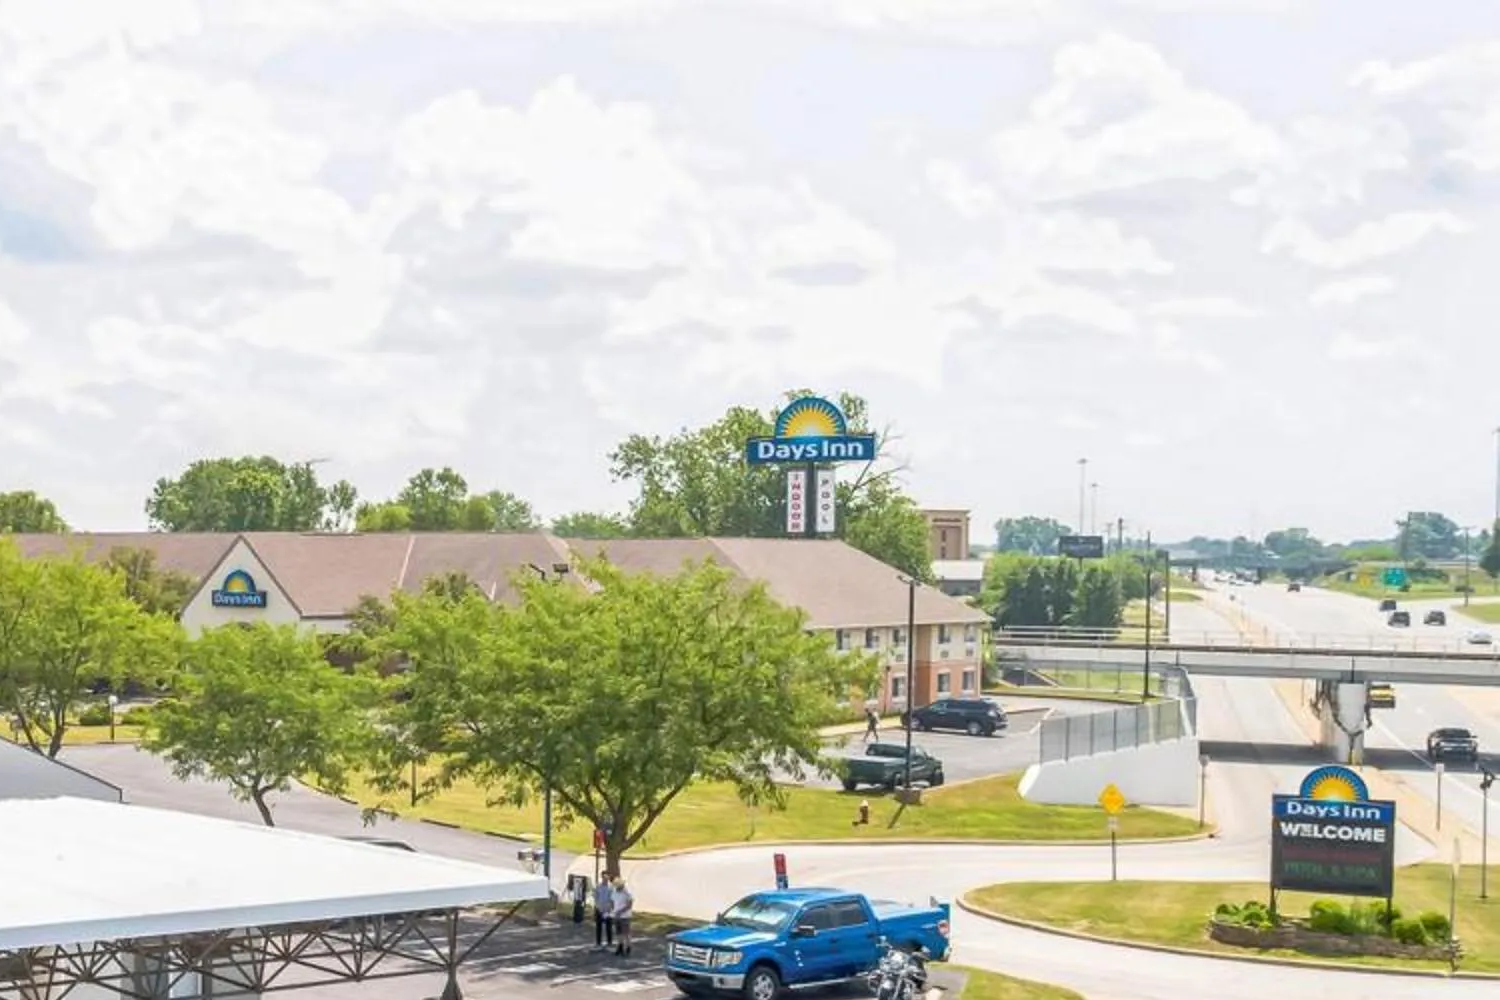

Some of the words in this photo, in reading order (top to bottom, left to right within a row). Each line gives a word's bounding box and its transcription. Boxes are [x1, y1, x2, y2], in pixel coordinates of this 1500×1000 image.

[757, 441, 818, 460] Days
[822, 440, 863, 457] Inn
[1287, 801, 1340, 817] Days
[1344, 804, 1380, 819] Inn
[1280, 822, 1386, 843] WELCOME
